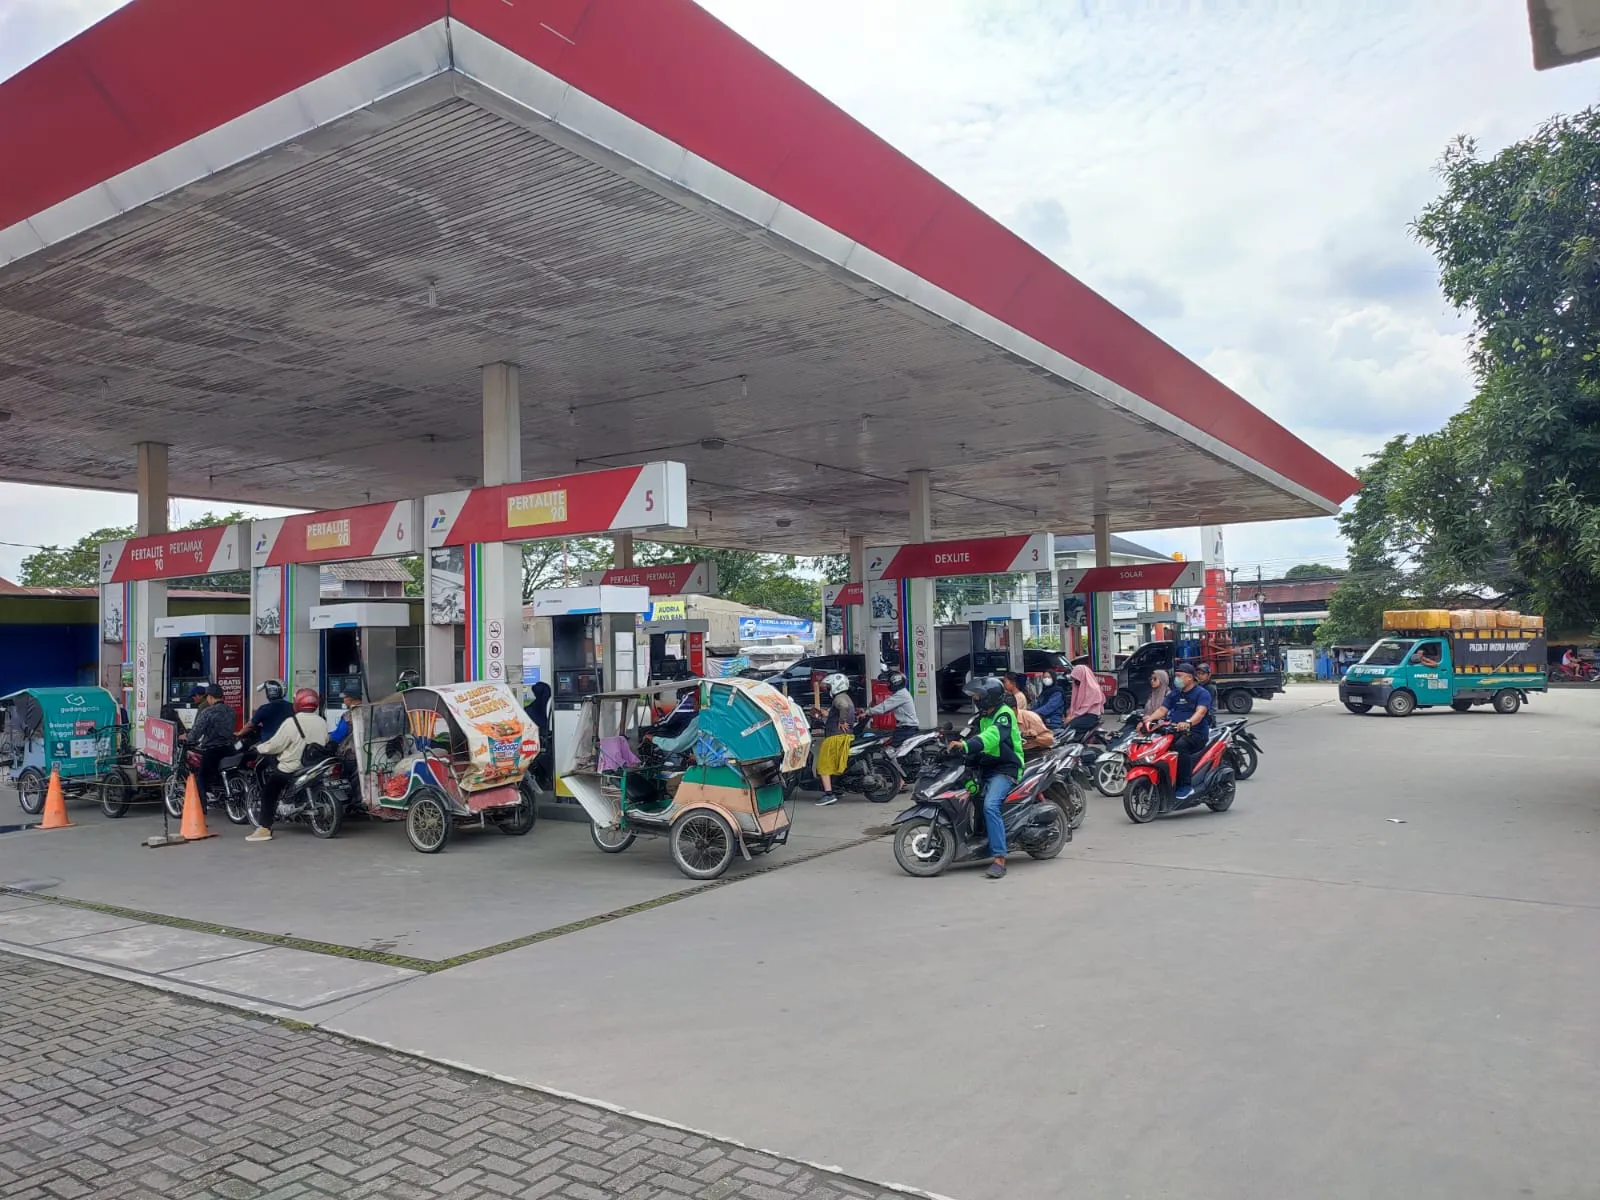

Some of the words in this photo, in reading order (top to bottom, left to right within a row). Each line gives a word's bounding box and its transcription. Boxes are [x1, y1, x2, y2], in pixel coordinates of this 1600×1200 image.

[508, 490, 565, 512] PERTALITE
[645, 490, 654, 512] 5
[551, 507, 565, 521] 90
[307, 520, 349, 537] PERTALITE
[396, 522, 404, 541] 6
[338, 534, 349, 546] 90
[131, 545, 164, 561] PERTALITE
[169, 540, 203, 555] PERTAMAX
[226, 544, 233, 560] 7
[1031, 549, 1039, 562] 3
[154, 559, 164, 571] 90
[194, 552, 203, 563] 92
[935, 552, 970, 564] DEXLITE
[610, 574, 640, 584] PERTALITE
[646, 572, 676, 581] PERTAMAX
[697, 575, 702, 586] 4
[1120, 571, 1143, 579] SOLAR
[1191, 572, 1196, 581] 1
[218, 679, 241, 687] GRATIS
